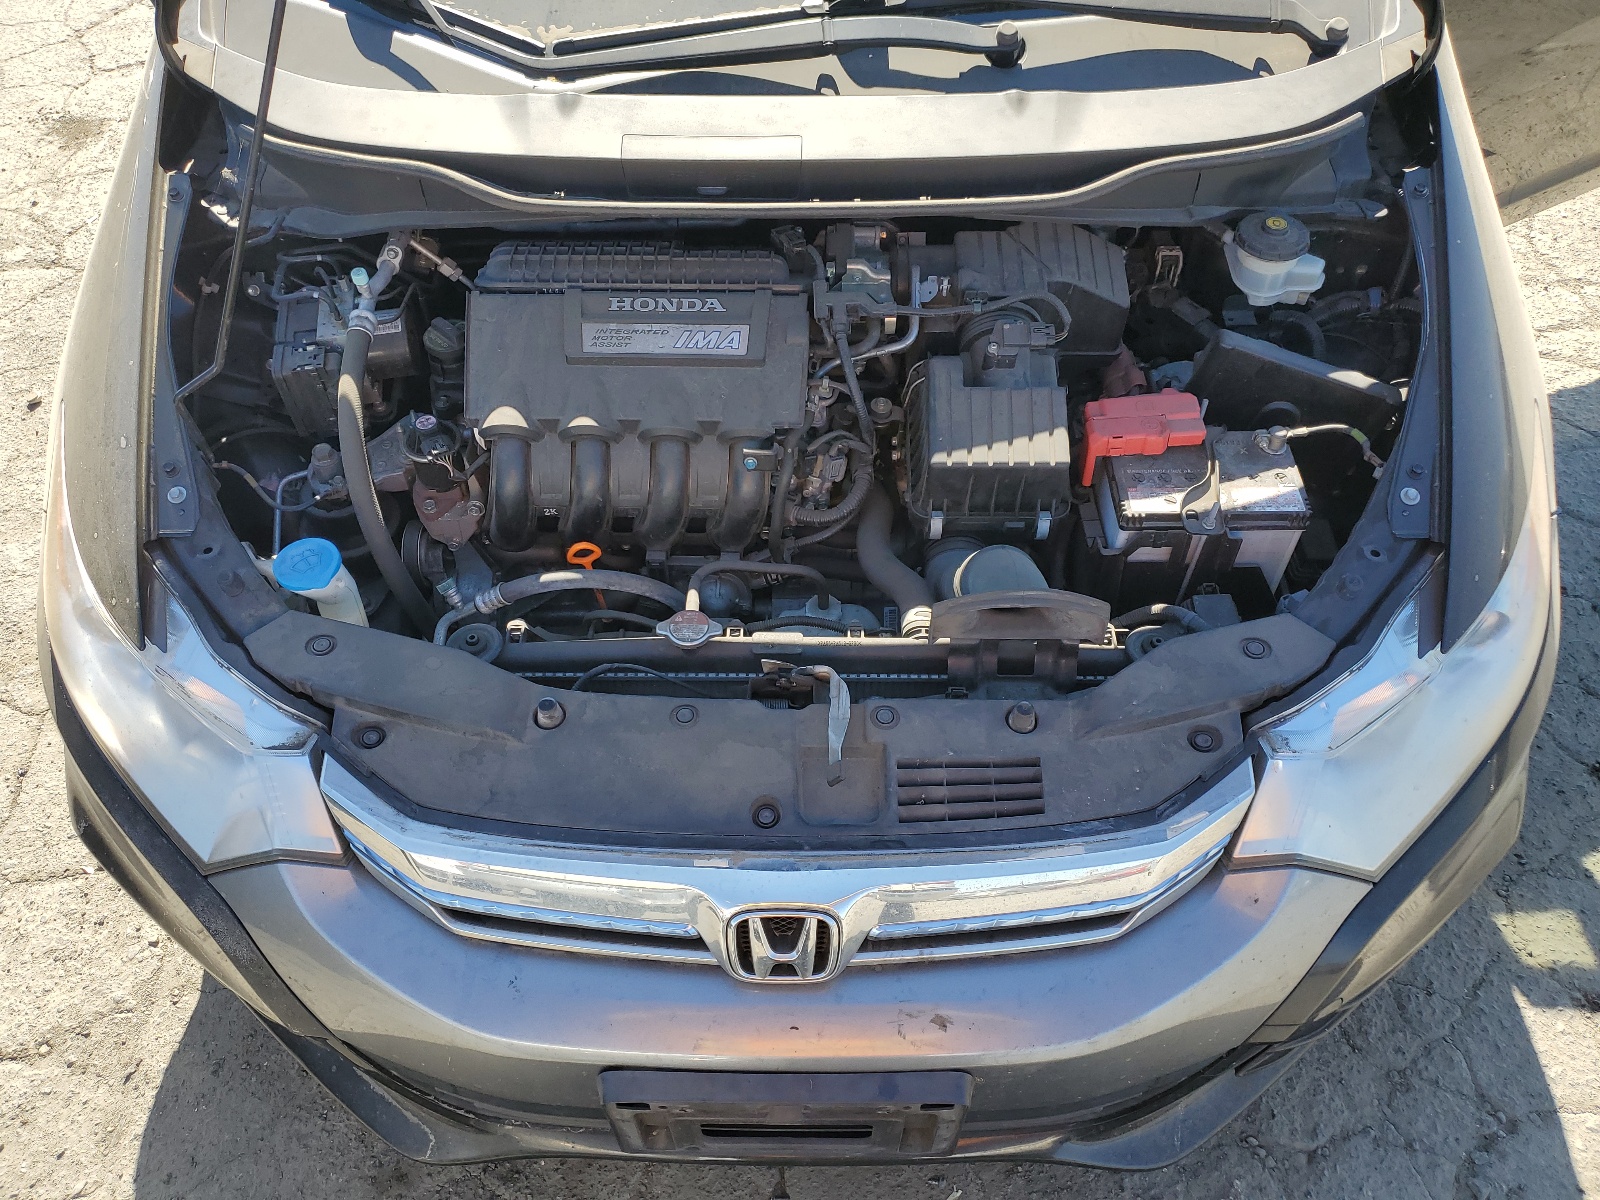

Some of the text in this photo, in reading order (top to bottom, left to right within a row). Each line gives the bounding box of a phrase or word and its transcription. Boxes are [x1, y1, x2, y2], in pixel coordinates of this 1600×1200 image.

[608, 297, 727, 312] HONDA
[595, 328, 670, 336] INTEGRATED
[673, 329, 742, 350] IMA
